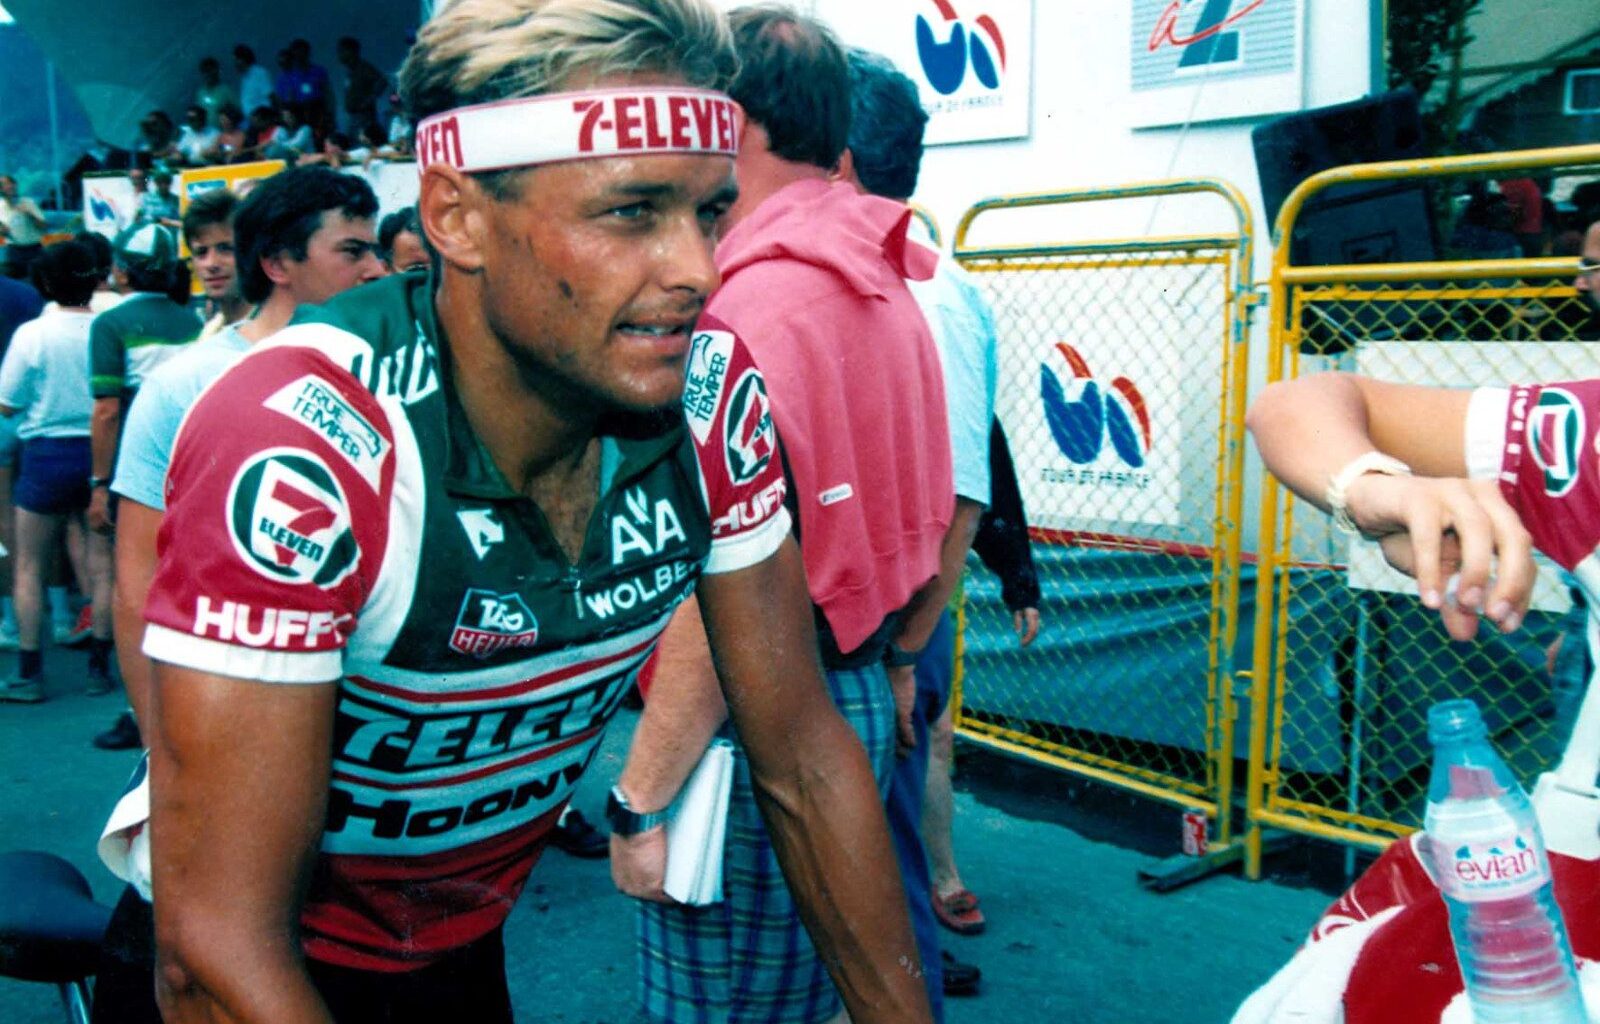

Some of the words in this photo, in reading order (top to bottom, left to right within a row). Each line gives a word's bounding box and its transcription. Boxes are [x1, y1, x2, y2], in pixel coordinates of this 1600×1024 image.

[303, 379, 347, 419] TRUE
[684, 371, 705, 412] TRUE
[695, 352, 727, 422] TEMPER
[291, 396, 360, 460] TEMPER
[270, 480, 338, 567] 7
[1455, 848, 1537, 881] evian
